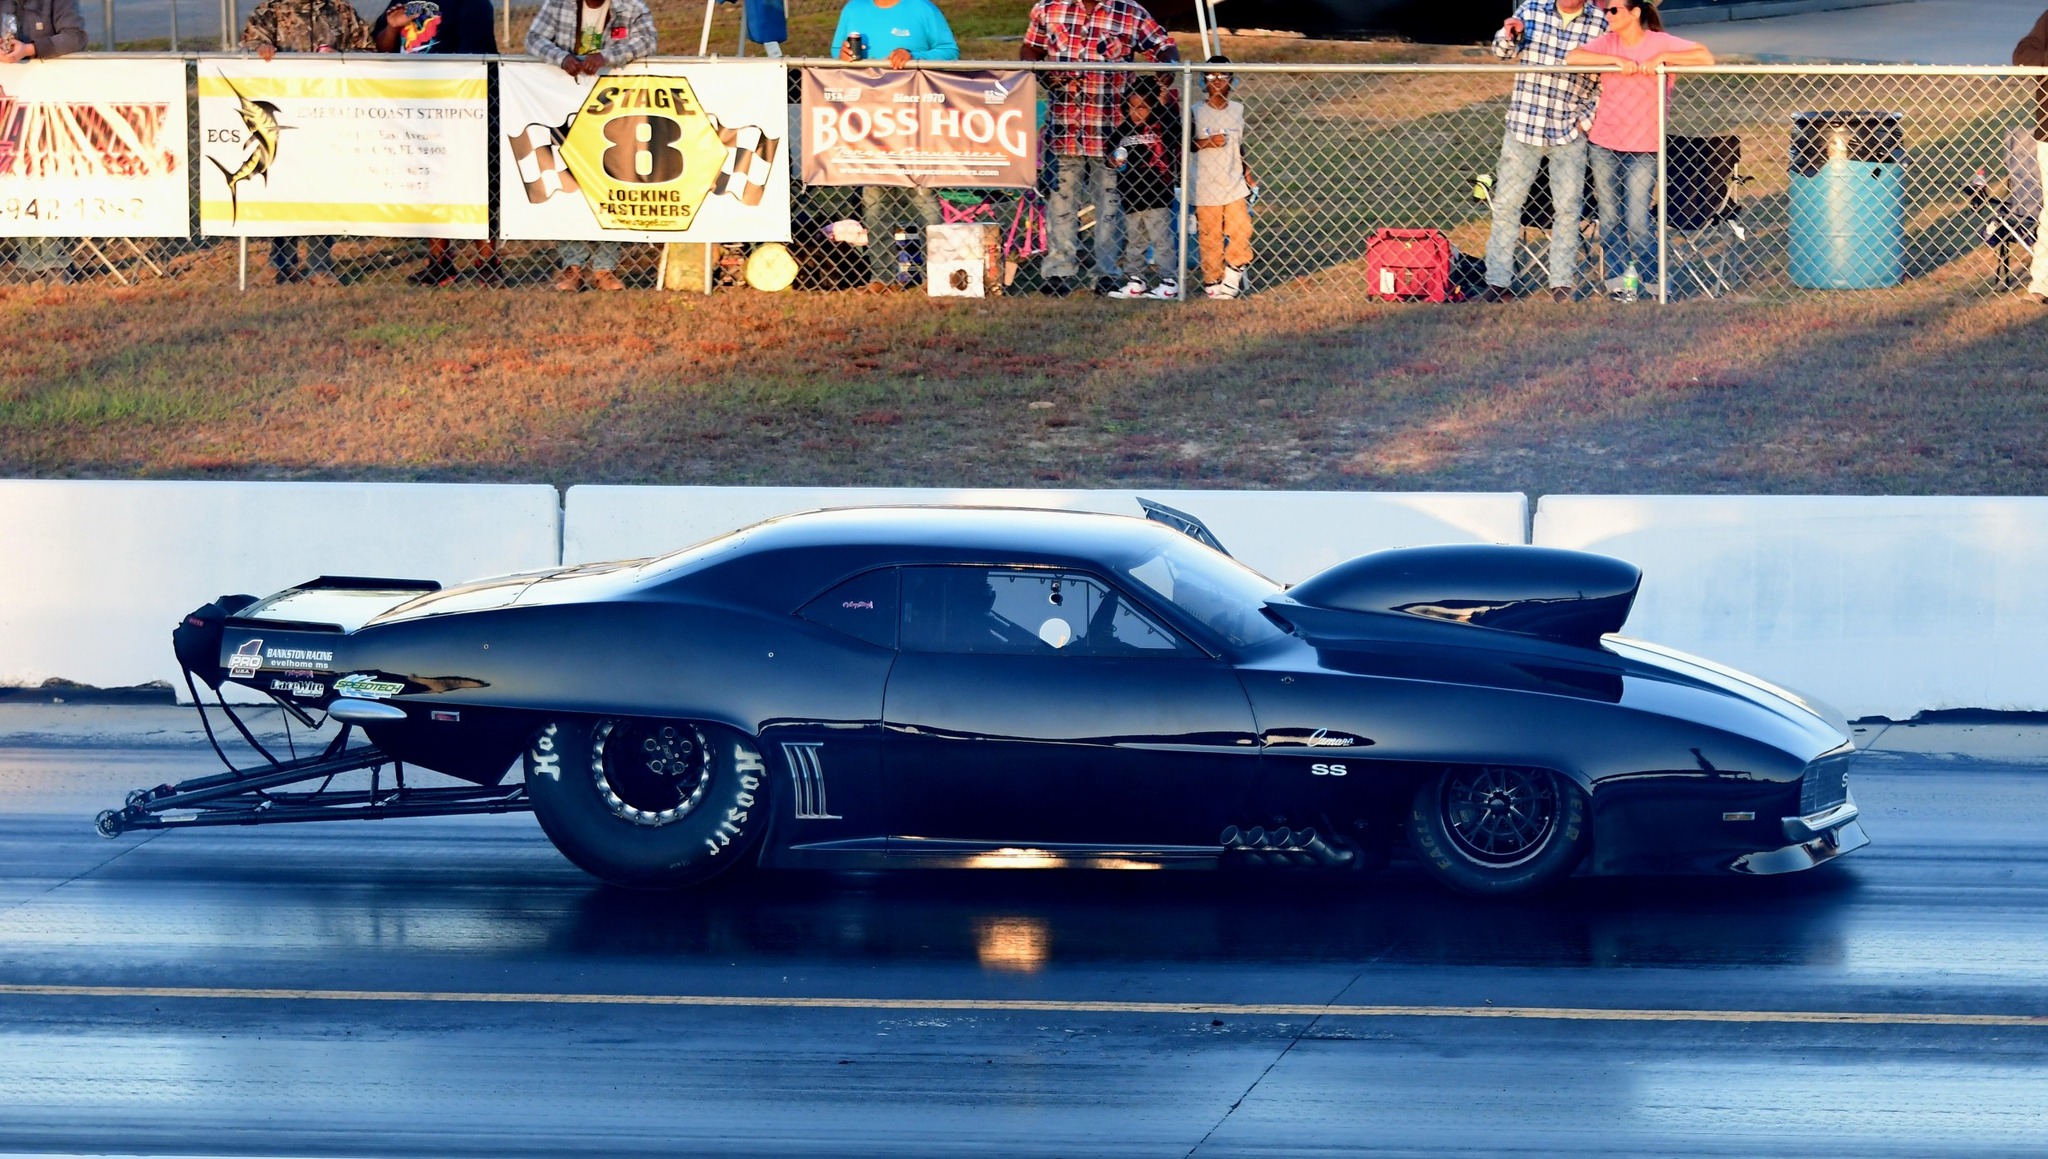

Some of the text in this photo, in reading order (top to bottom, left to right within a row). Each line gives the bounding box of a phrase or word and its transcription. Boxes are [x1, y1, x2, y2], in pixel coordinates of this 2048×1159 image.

[586, 87, 696, 116] STAGE
[893, 93, 946, 104] Since 1970
[368, 107, 412, 119] COAST
[416, 107, 484, 119] STRIPING
[207, 129, 240, 143] ECS
[812, 106, 1027, 158] BOSS HOG
[602, 114, 684, 184] 8
[608, 189, 680, 202] LOCKING
[600, 202, 691, 217] FASTENERS
[267, 649, 333, 661] BANKSTON RACING
[229, 656, 262, 668] PRO
[336, 680, 402, 692] SPEEDTECH
[1307, 728, 1354, 747] Camaro
[1311, 763, 1348, 776] SS
[705, 744, 767, 856] Hoosier
